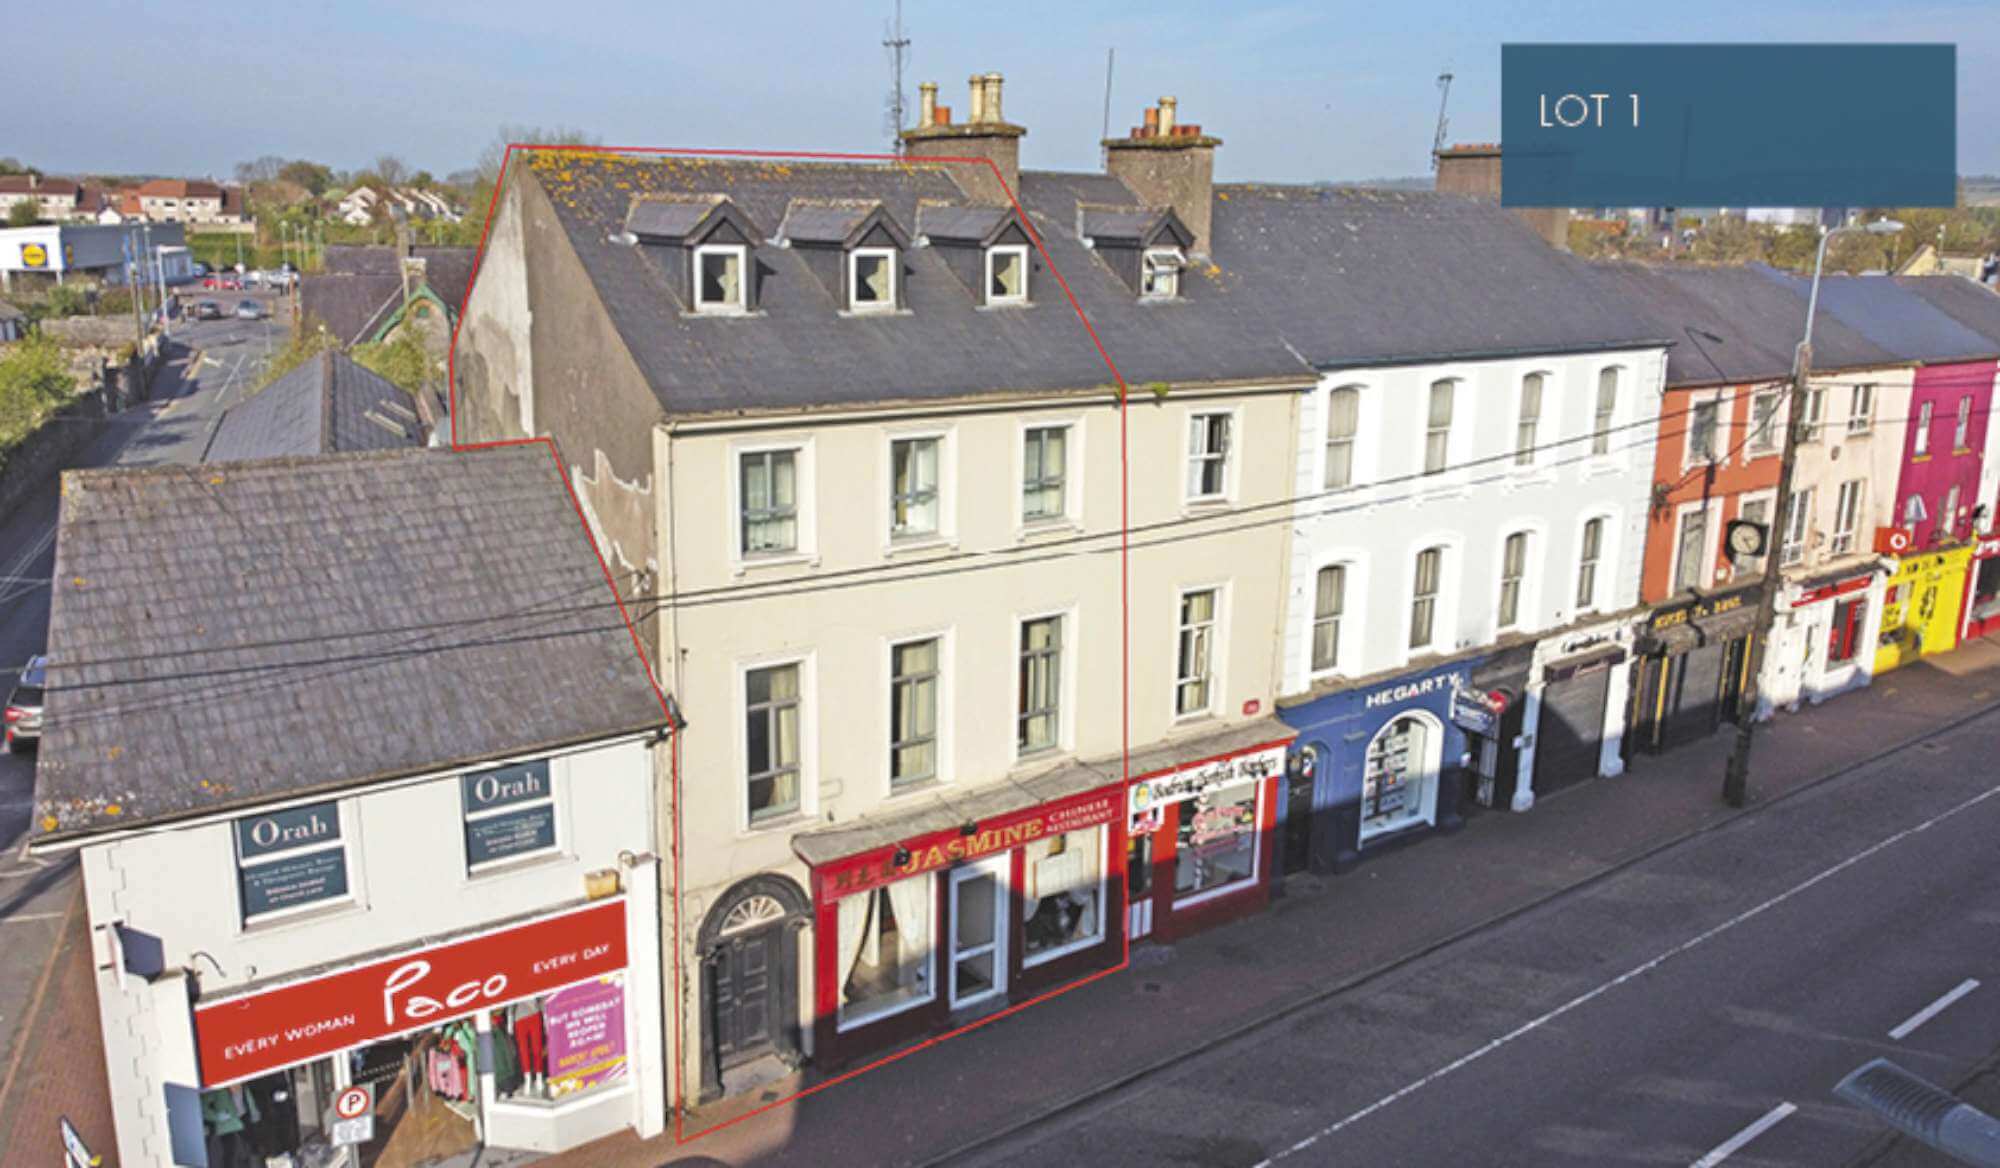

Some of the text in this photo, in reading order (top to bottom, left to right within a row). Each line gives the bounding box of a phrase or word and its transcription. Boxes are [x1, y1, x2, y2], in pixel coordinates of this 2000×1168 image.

[475, 772, 540, 802] Orah
[252, 815, 327, 847] Orah
[901, 817, 1044, 873] JASMINE
[224, 944, 610, 1060] EVERY WOMAN Paco EVERY DAY
[348, 1093, 361, 1113] P
